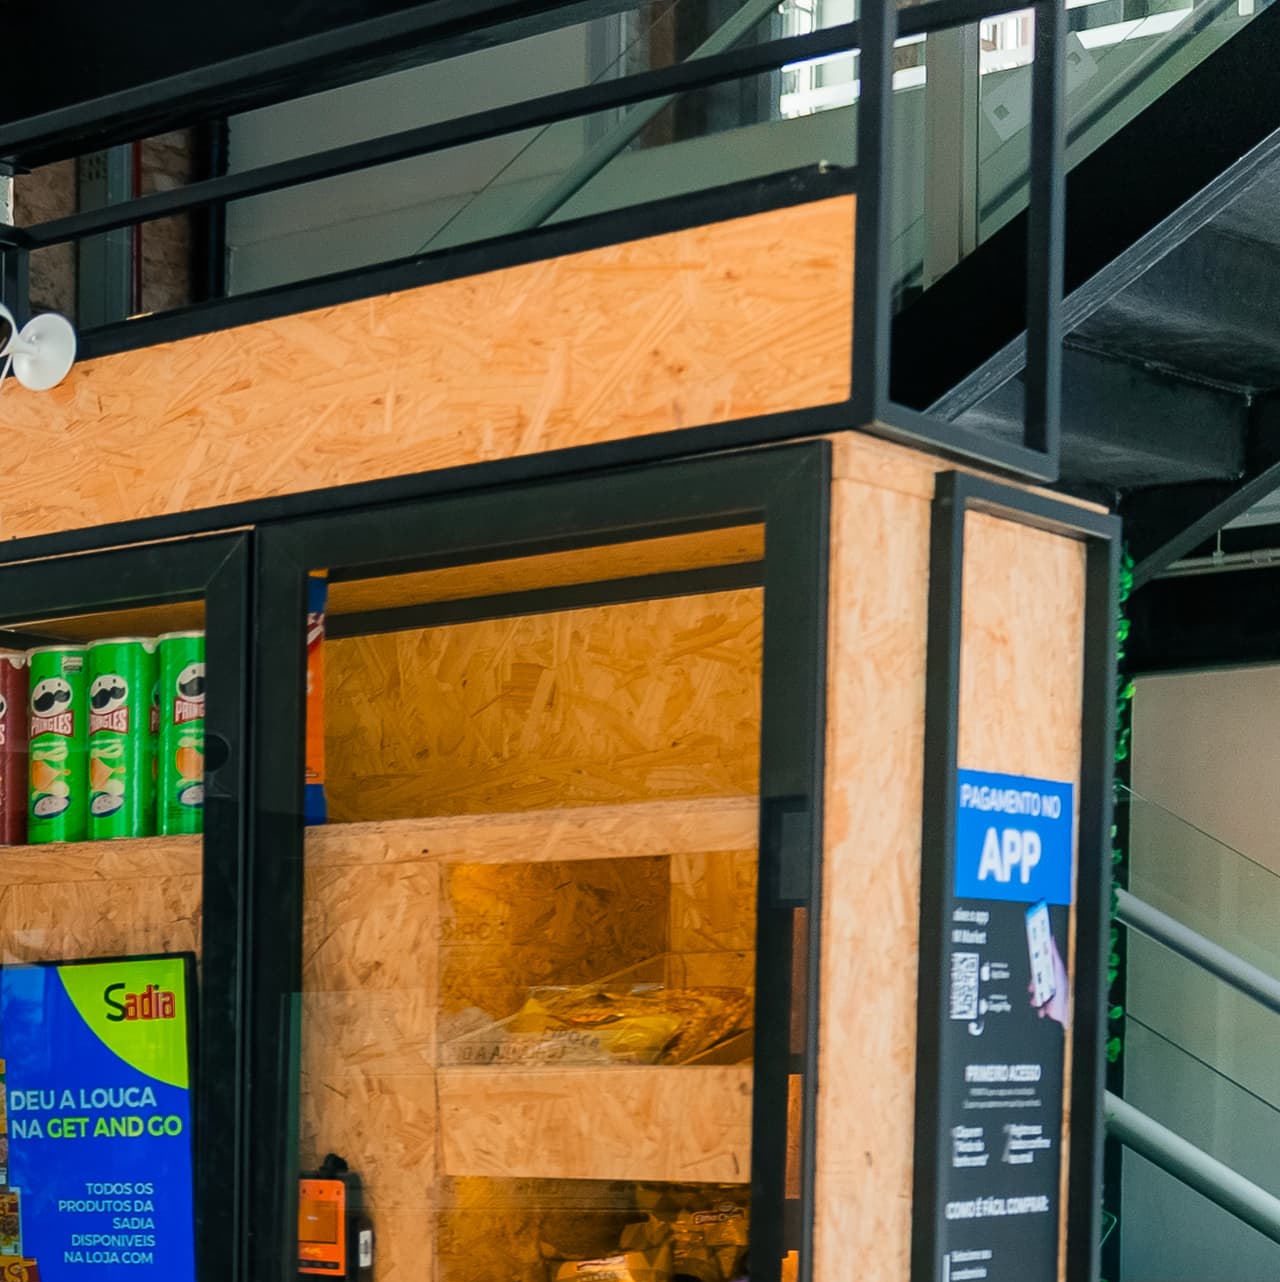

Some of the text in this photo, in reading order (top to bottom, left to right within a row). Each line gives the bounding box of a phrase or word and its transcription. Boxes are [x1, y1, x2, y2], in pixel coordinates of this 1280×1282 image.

[960, 783, 1061, 820] PAGAMENTO NO
[977, 826, 1042, 885] APP
[103, 982, 176, 1022] Sadia
[9, 1086, 158, 1111] DEU A LOUCA
[11, 1114, 183, 1140] NA GET AND GO
[85, 1182, 155, 1196] TODOS OS
[58, 1199, 155, 1213] PRODUTOS DA
[112, 1217, 156, 1230] SADIA
[71, 1234, 156, 1247] DISPONIVEIS
[63, 1251, 154, 1265] NA LOJA COM
